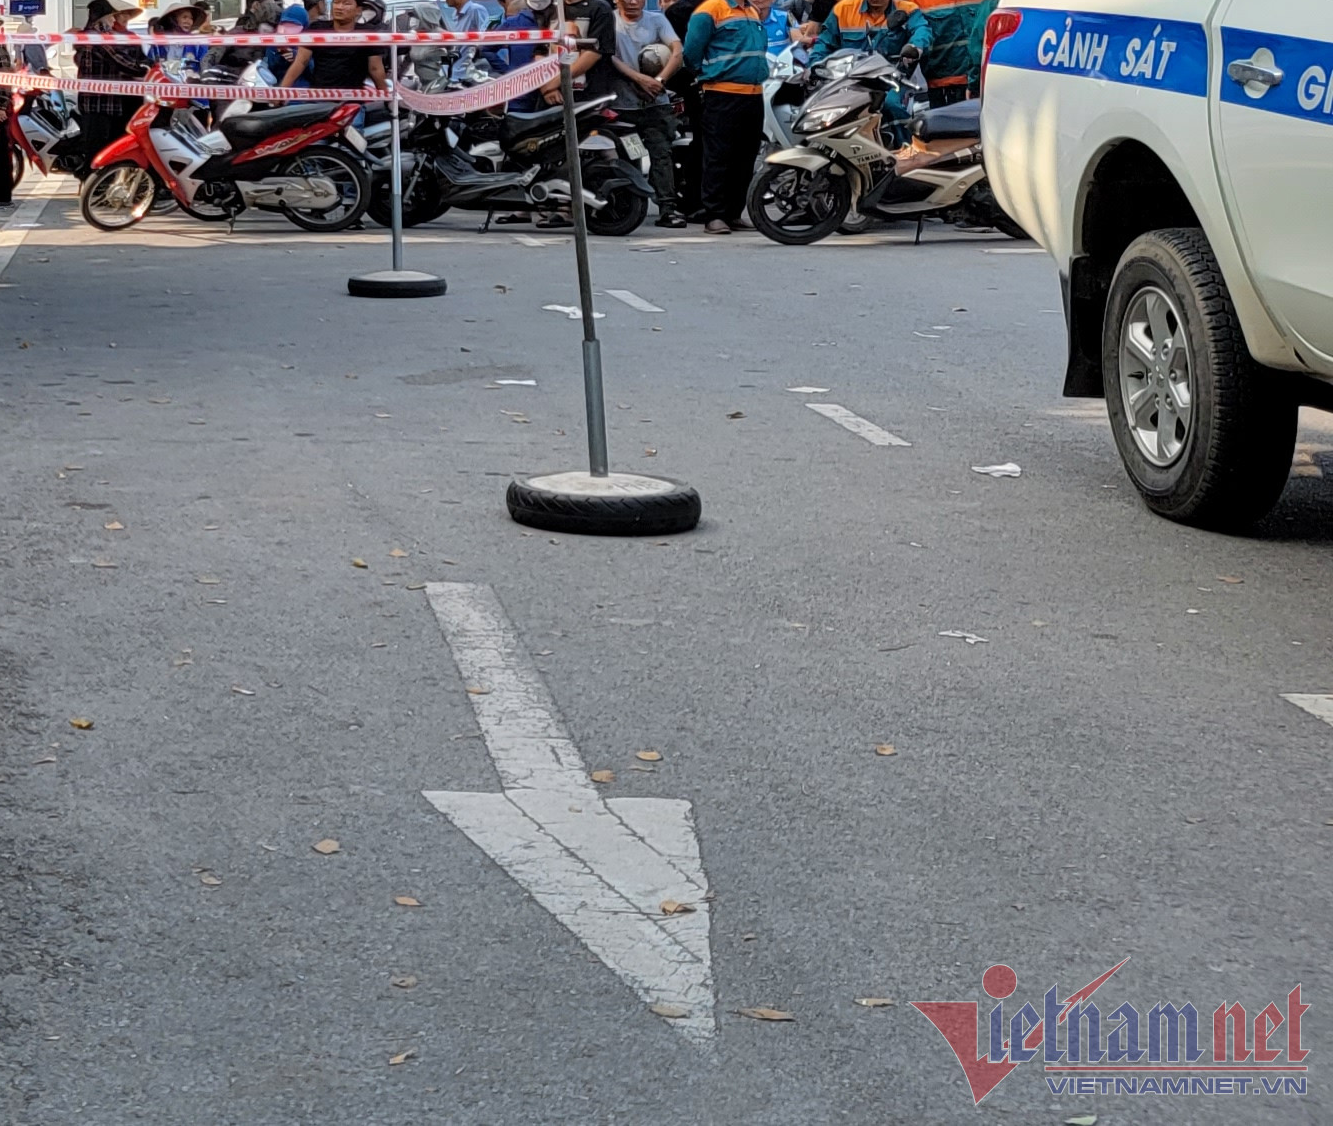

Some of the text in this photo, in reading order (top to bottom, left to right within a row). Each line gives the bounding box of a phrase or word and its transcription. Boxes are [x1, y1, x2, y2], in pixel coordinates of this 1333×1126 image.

[1036, 17, 1109, 71] CẢNH
[1119, 23, 1177, 81] SÁT
[857, 152, 882, 164] YAMAHA
